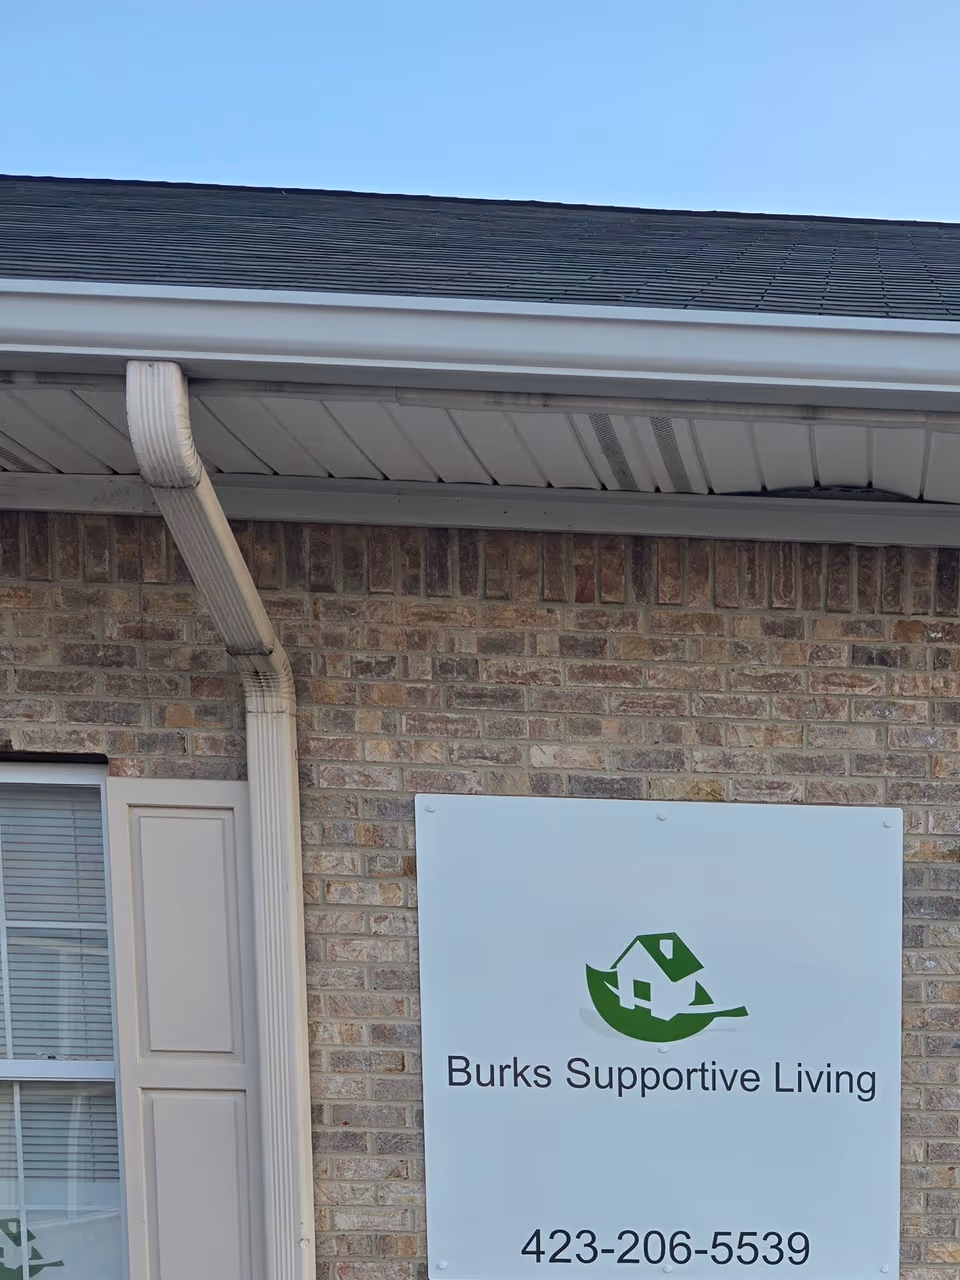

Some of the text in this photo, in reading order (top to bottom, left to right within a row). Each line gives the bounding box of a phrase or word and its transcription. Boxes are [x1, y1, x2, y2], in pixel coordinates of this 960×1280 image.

[447, 1051, 876, 1103] Burks Supportive Living
[520, 1228, 810, 1266] 423-206-5539
